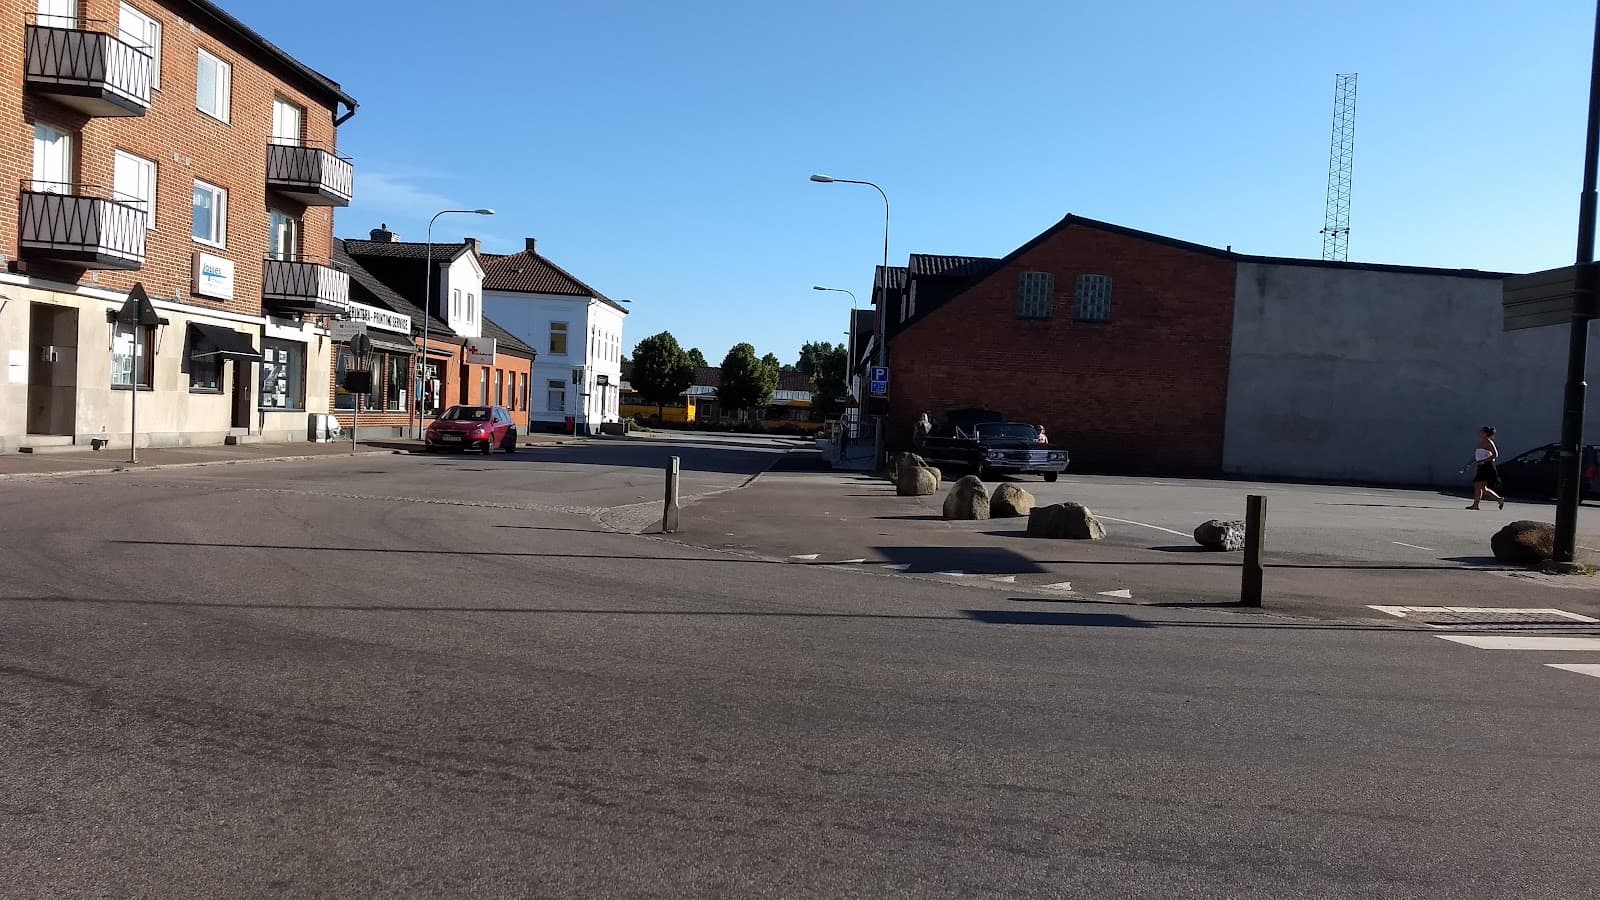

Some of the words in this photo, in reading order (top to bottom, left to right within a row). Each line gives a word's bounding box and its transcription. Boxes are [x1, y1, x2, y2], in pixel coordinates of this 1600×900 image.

[373, 311, 391, 326] PRINTING
[392, 315, 408, 330] SERVICE
[876, 368, 885, 380] P
